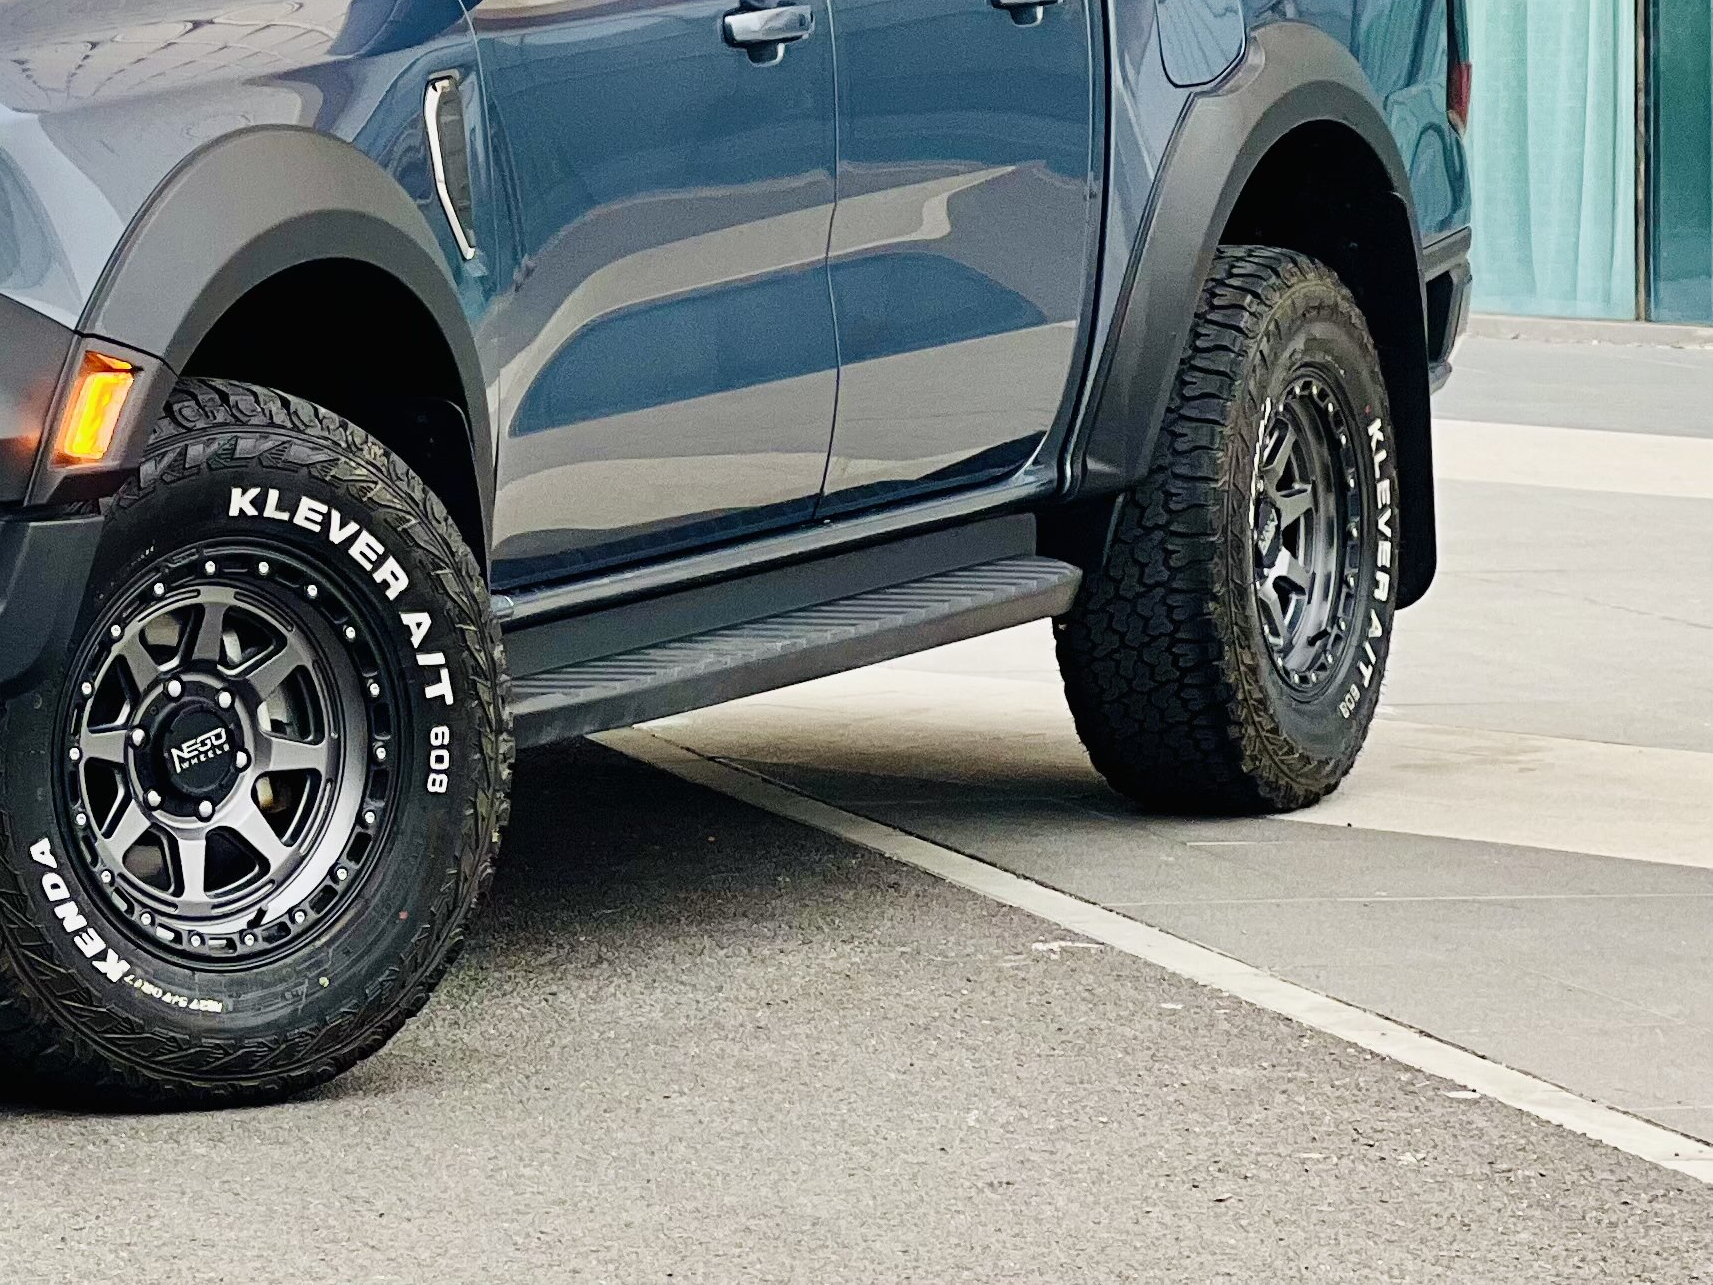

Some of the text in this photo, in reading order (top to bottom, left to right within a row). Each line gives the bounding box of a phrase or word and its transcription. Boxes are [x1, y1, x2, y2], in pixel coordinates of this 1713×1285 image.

[1367, 416, 1392, 603] KLEVER
[228, 485, 410, 601] KLEVER
[425, 723, 451, 794] 608
[29, 836, 132, 983] KENDA
